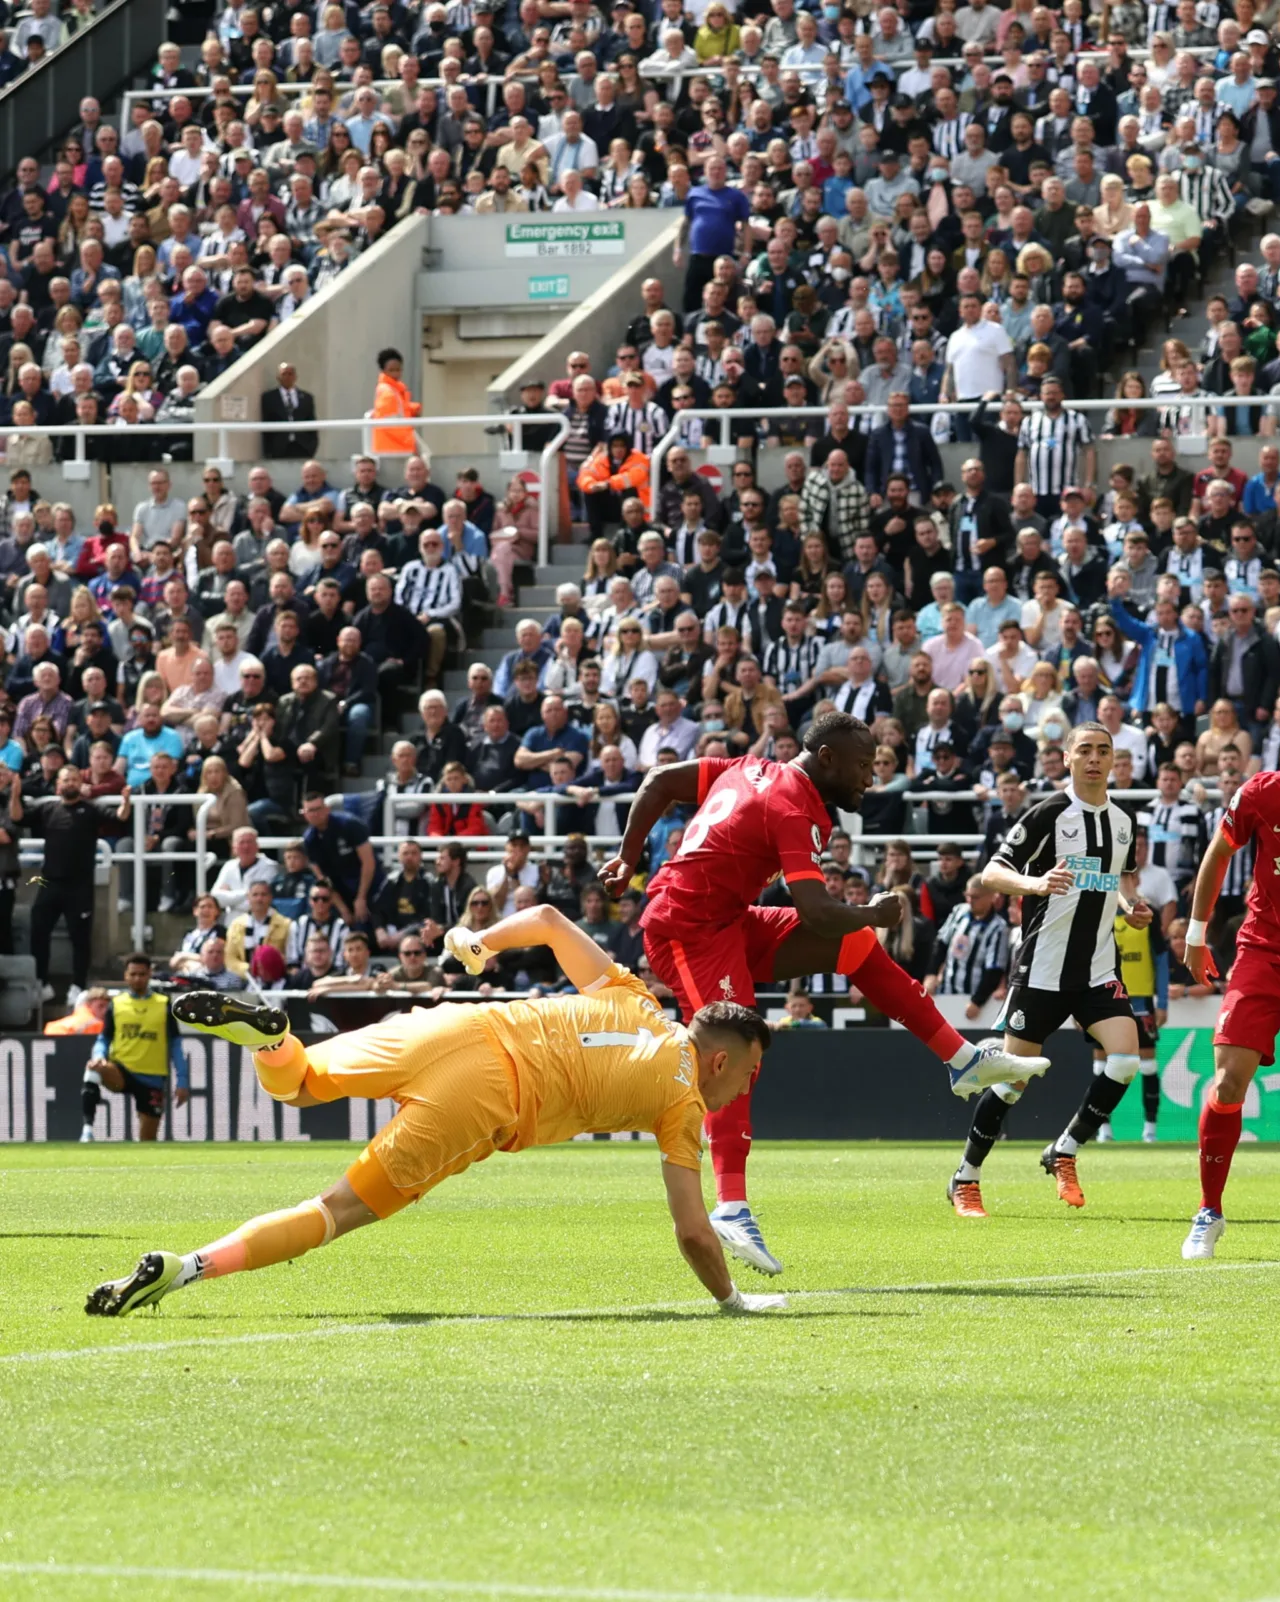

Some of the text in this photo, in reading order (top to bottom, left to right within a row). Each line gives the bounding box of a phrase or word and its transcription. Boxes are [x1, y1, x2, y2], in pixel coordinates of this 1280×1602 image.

[510, 221, 619, 241] Emergency exit
[537, 240, 592, 256] Bar 1892
[530, 281, 557, 294] EXIT
[676, 788, 738, 857] 8
[0, 1038, 56, 1142] OF
